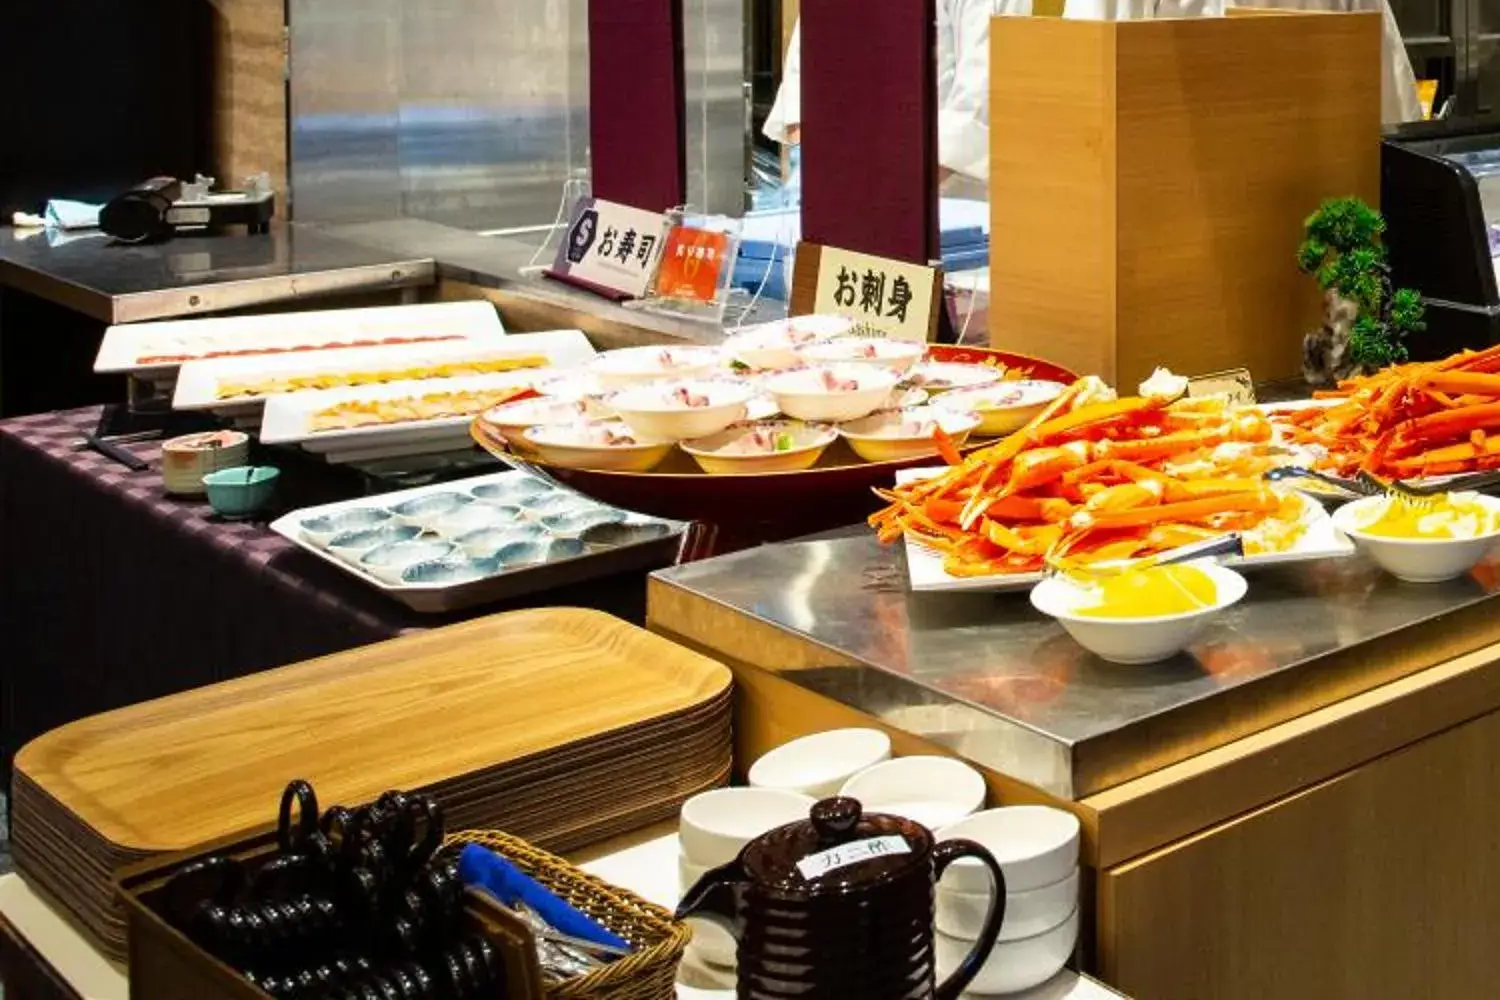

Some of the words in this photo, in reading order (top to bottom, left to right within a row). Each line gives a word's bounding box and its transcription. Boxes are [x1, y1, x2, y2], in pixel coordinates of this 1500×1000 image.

[597, 225, 656, 270] お寿司
[834, 265, 912, 324] お刺身
